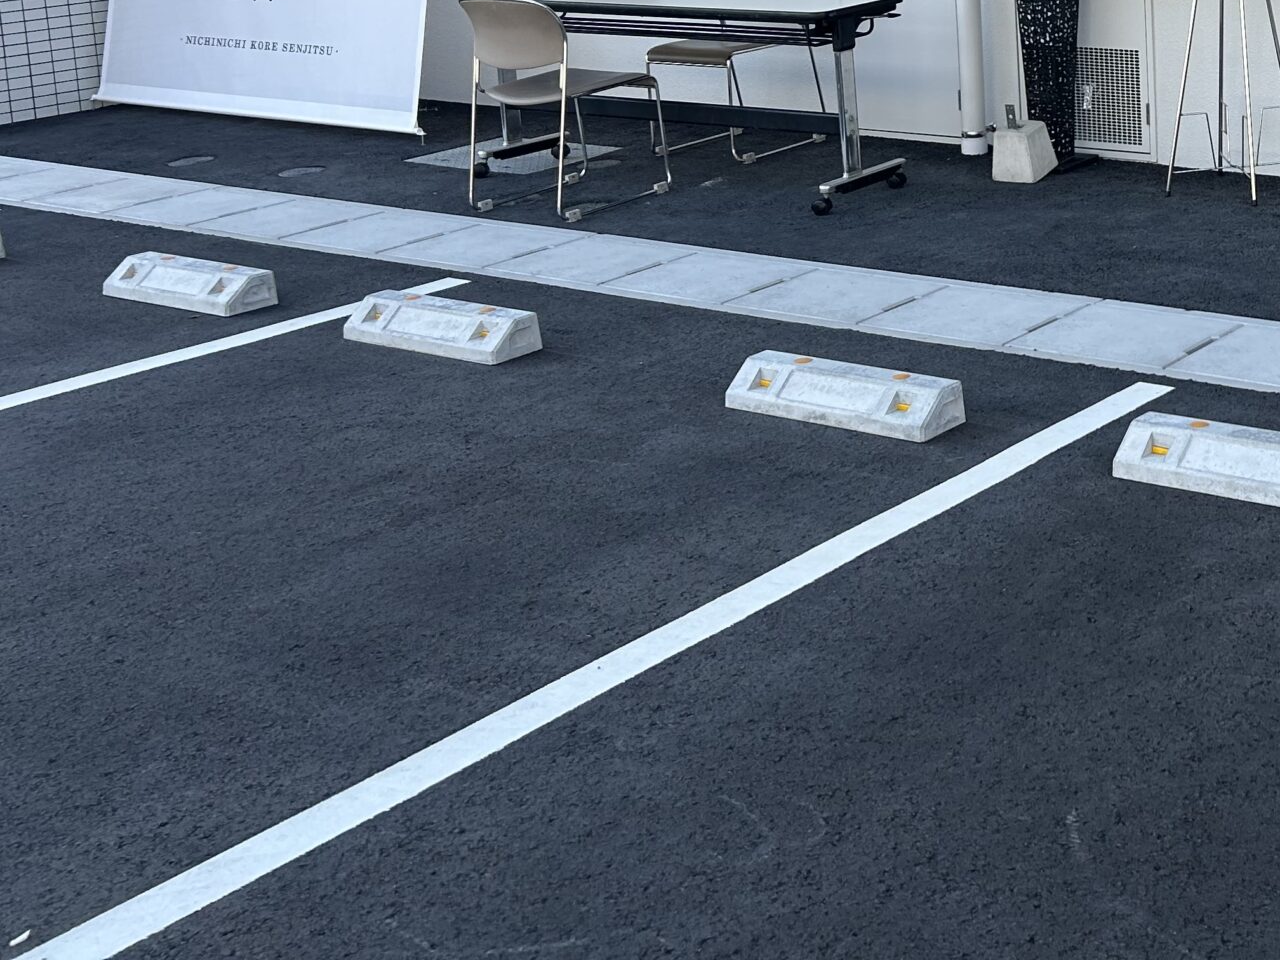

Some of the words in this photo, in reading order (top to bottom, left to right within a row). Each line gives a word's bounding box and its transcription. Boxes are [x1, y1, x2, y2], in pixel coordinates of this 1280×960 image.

[185, 35, 247, 50] NICHINICHI
[250, 41, 279, 53] KORE
[282, 42, 333, 57] SENJITSU
